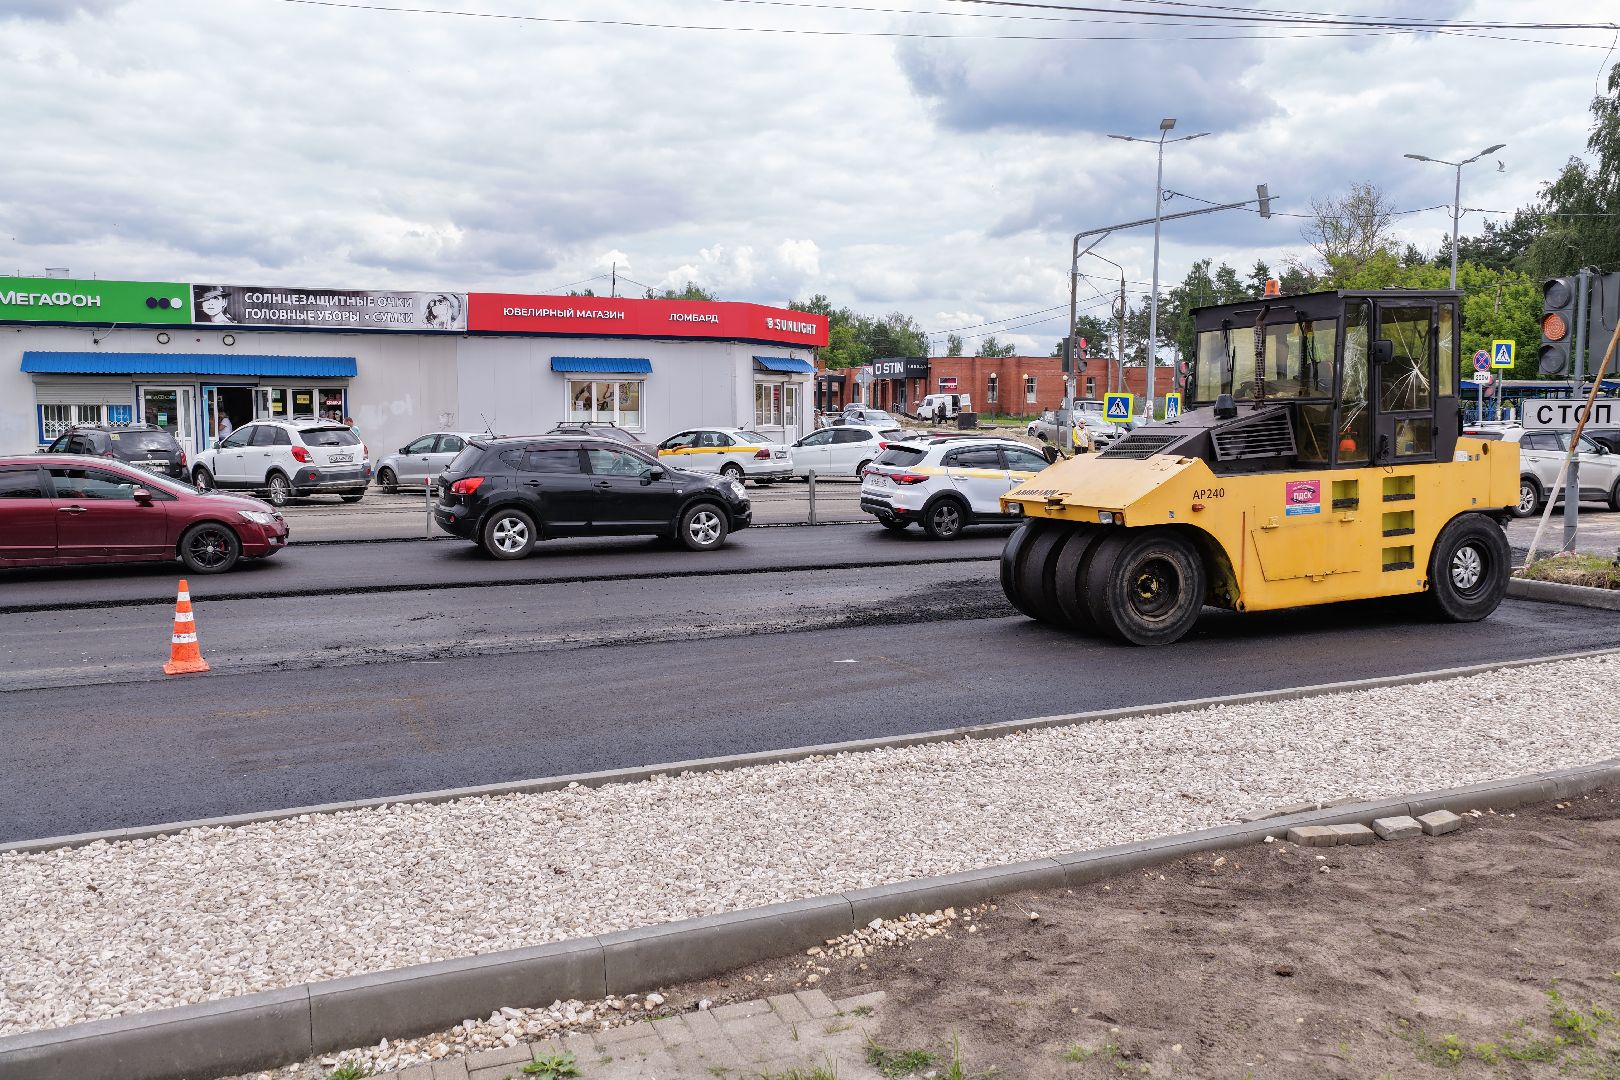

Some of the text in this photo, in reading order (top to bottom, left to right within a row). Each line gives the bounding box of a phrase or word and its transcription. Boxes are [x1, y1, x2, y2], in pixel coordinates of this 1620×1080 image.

[244, 292, 413, 308] СОЛНЦЕЗАЩИТНЫЕ ОЧКИ
[245, 308, 414, 323] ГОЛОВНЫЕ УБОРЫ СУМКИ
[503, 307, 625, 320] ЮВЕЛИРНЫЙ МАГАЗИН
[668, 312, 719, 324] ЛОМБАРД
[774, 318, 817, 335] SUNLIGHT
[1536, 404, 1612, 425] СТОП
[1192, 487, 1225, 501] AP240
